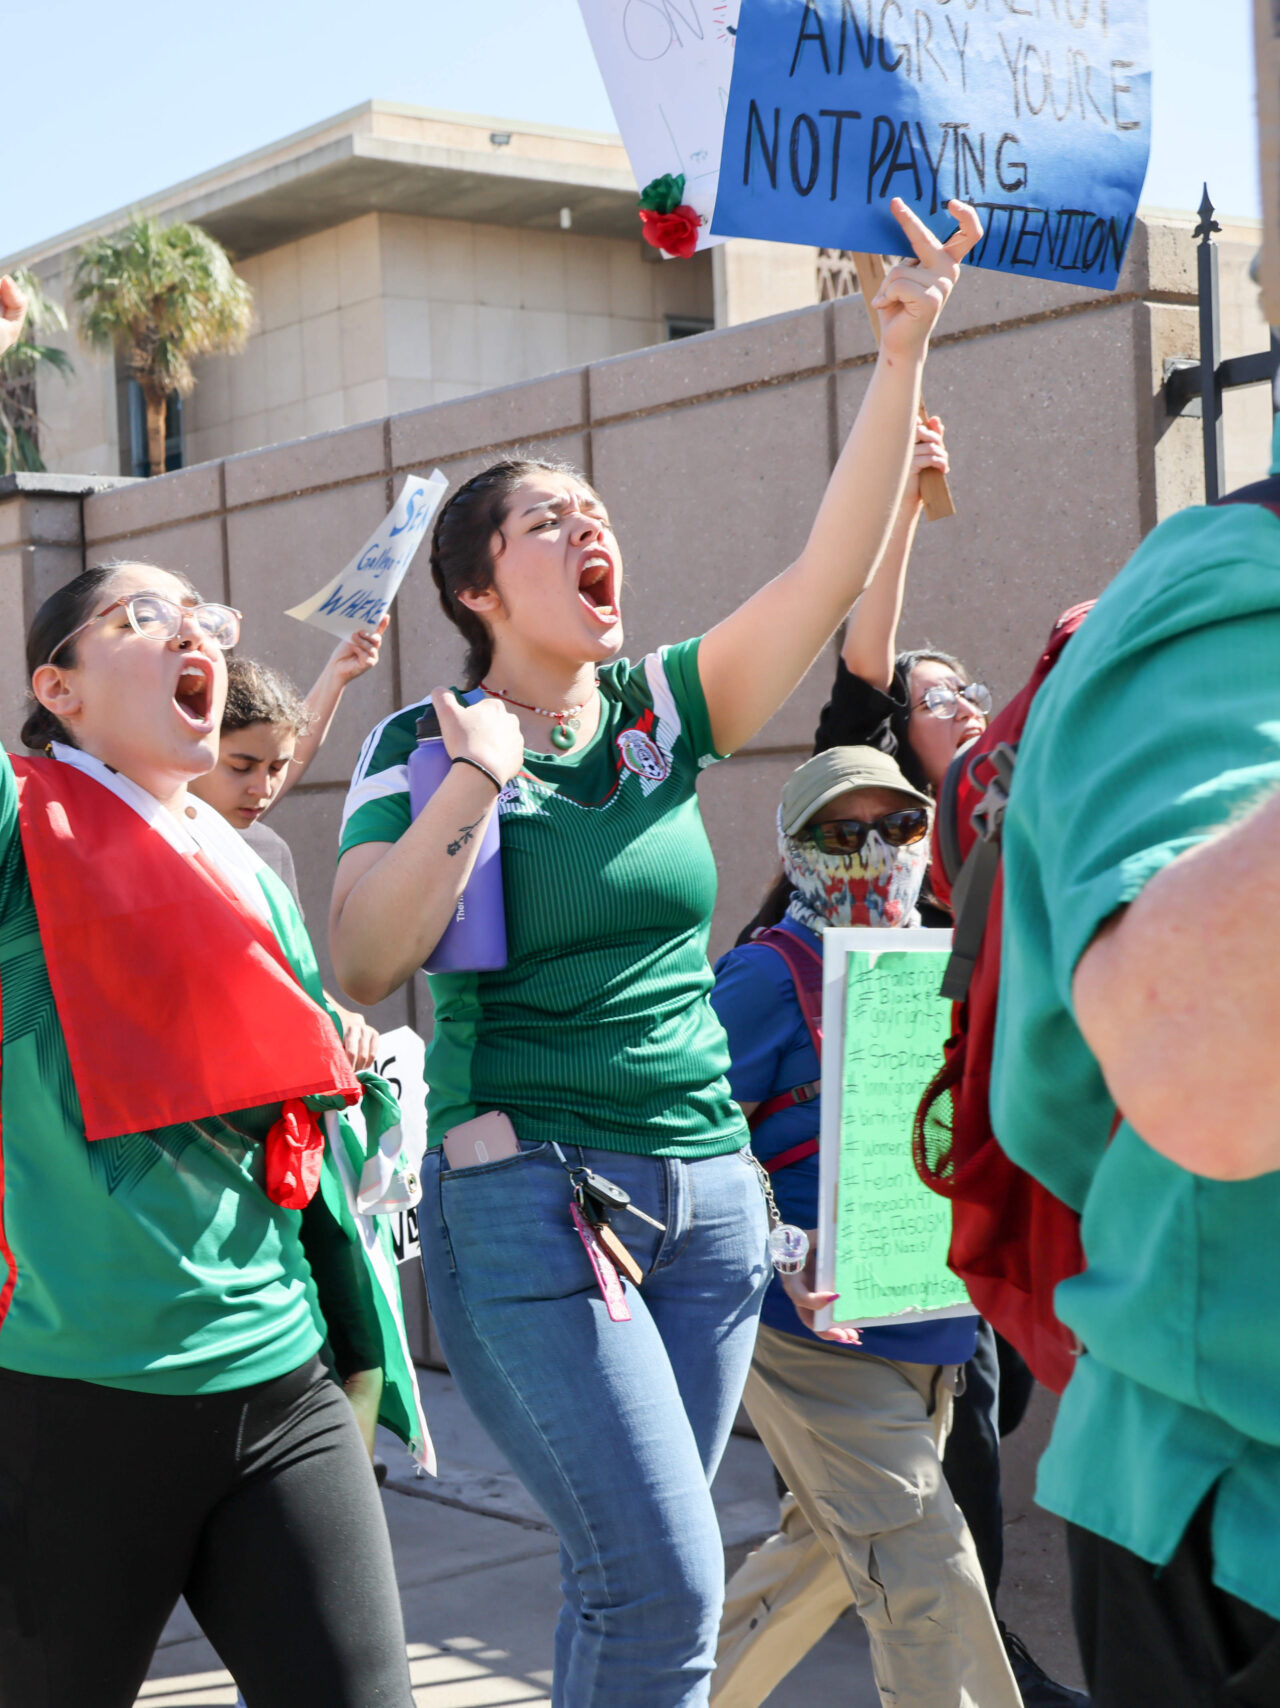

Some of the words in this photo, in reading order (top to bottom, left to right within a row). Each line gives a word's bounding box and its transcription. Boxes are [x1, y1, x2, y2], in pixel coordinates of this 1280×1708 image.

[790, 0, 970, 92] ANGRY
[742, 98, 862, 201] NOT
[867, 114, 1029, 216] PAYING
[941, 197, 1133, 275] TTENTION
[318, 584, 387, 624] WHERE
